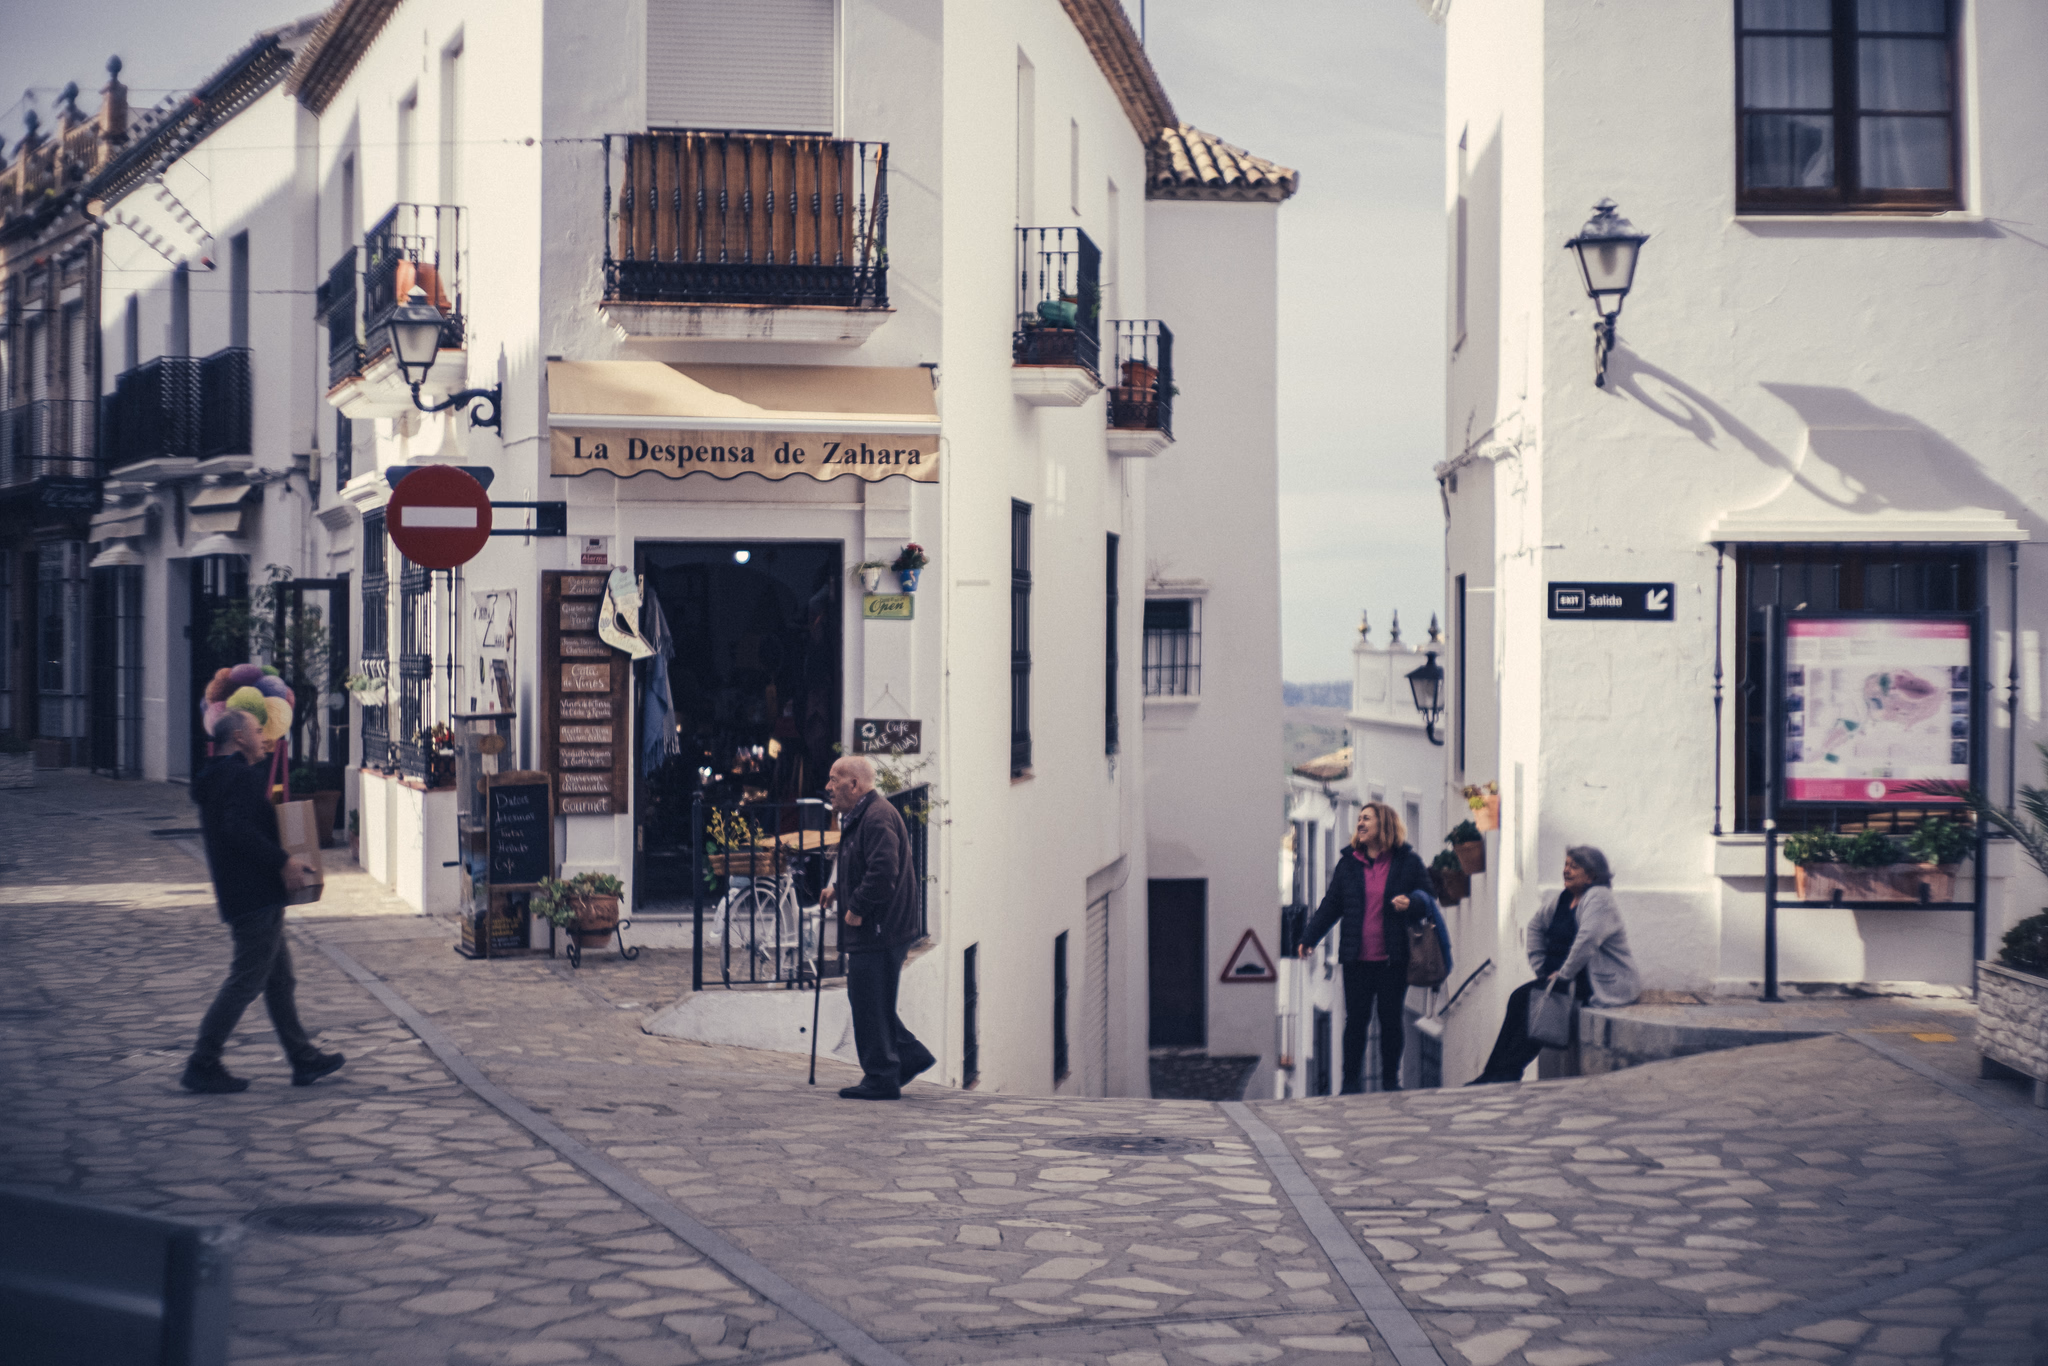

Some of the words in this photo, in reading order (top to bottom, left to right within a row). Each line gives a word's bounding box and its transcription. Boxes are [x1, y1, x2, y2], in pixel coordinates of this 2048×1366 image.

[573, 436, 609, 460] La
[627, 437, 756, 468] Despensa
[774, 441, 806, 464] de
[822, 441, 921, 465] Zahara
[869, 599, 905, 615] Open
[1588, 593, 1623, 608] Salida
[571, 664, 599, 676] Cata
[886, 720, 910, 737] Café
[862, 733, 891, 752] TAKE
[562, 797, 607, 813] Gourmet
